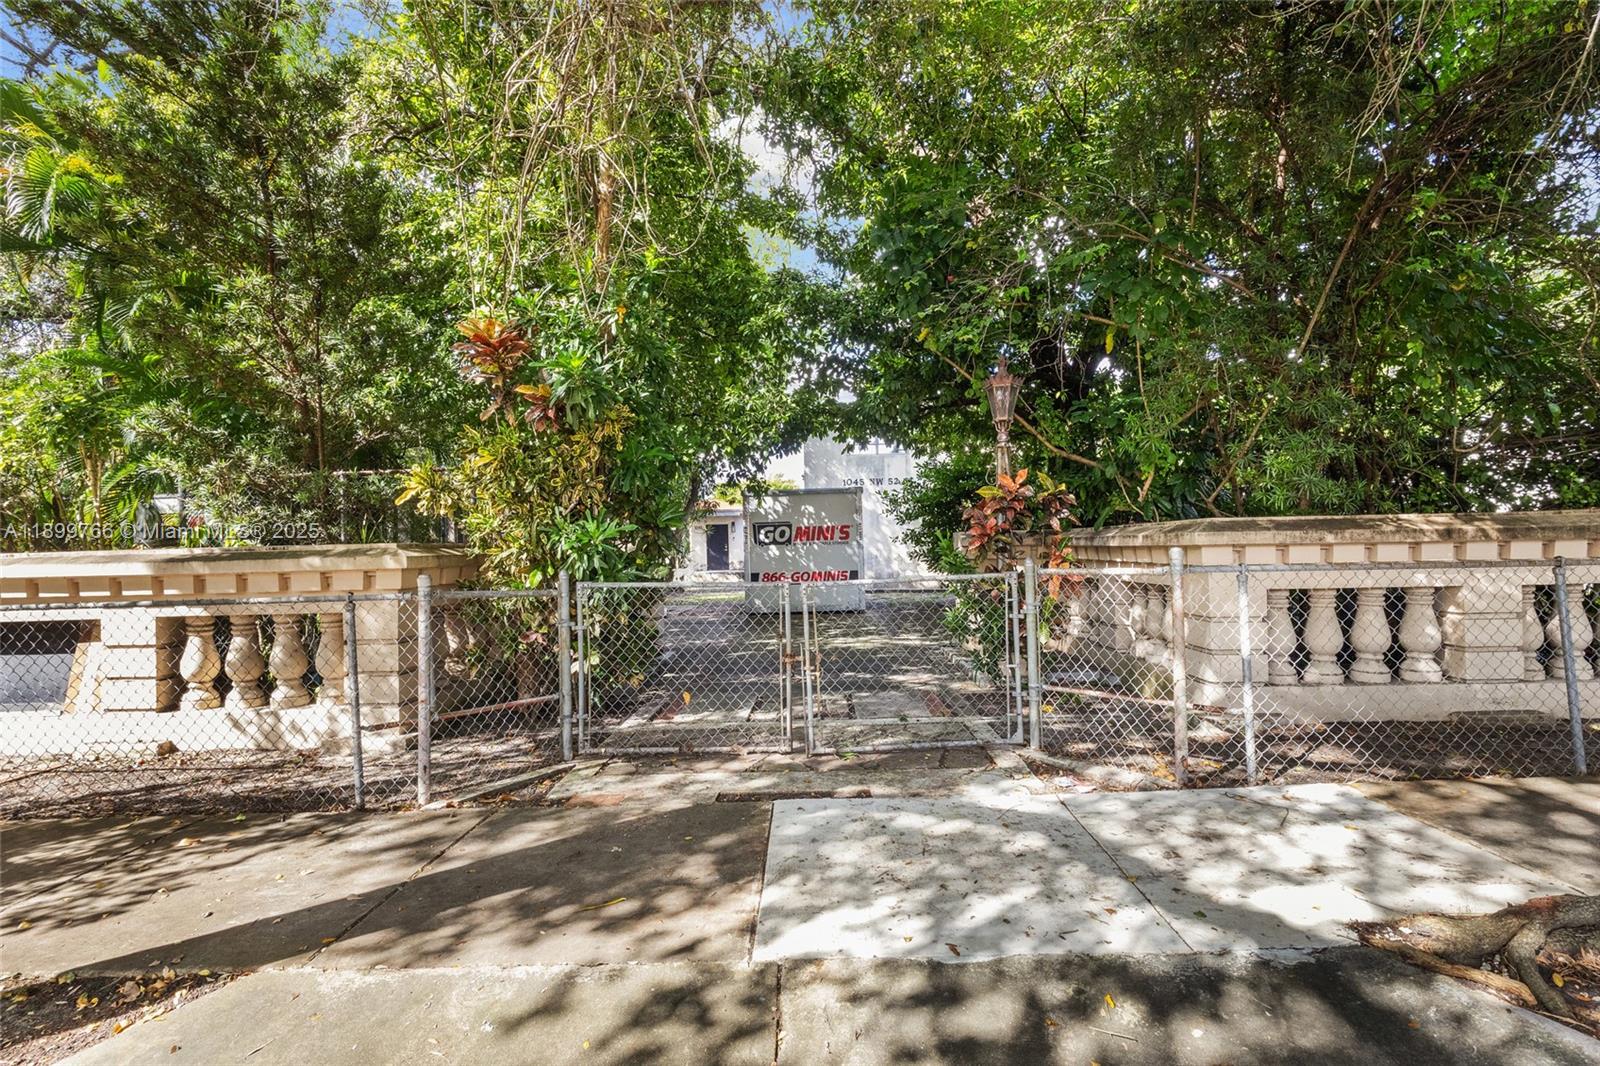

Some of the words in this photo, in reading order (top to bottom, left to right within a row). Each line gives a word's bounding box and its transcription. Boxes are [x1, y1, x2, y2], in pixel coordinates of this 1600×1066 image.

[842, 478, 864, 486] 1045
[870, 477, 884, 485] NW
[760, 526, 790, 543] GO
[793, 524, 850, 542] MINI'S
